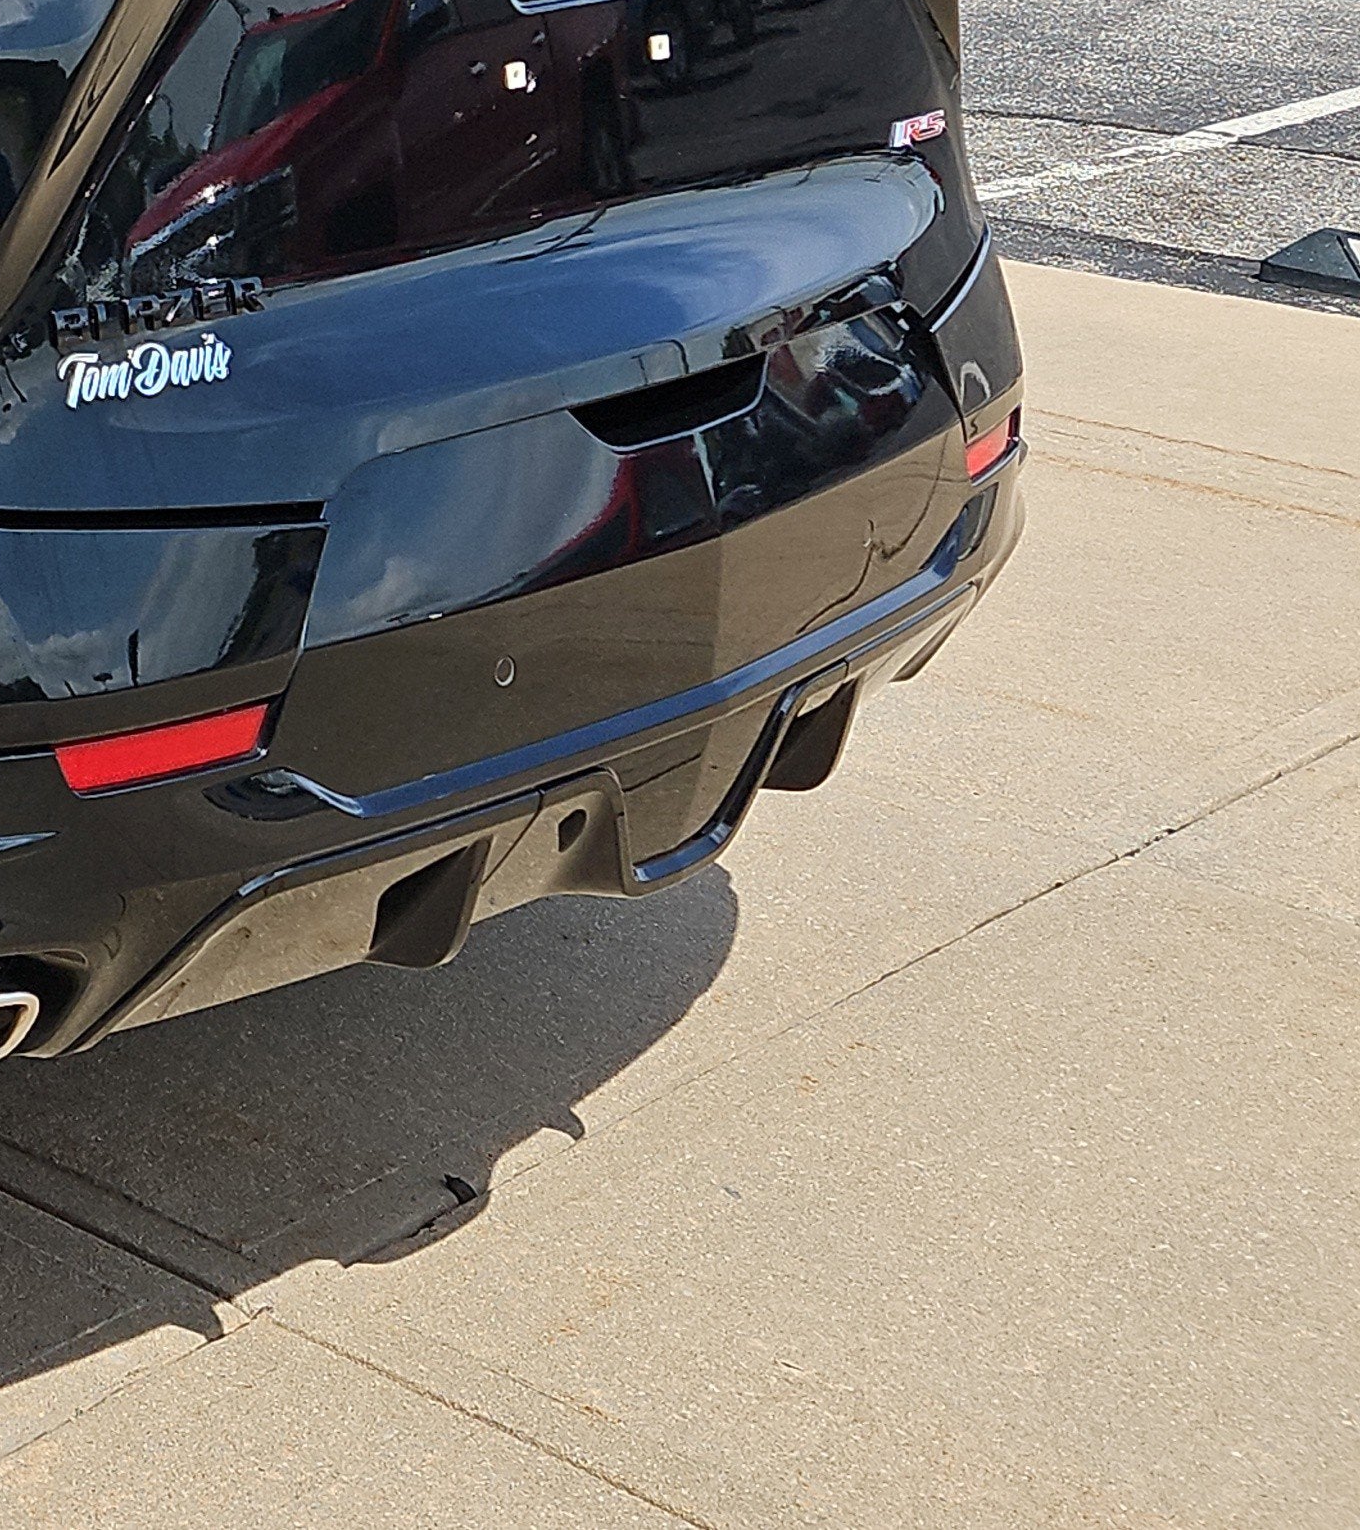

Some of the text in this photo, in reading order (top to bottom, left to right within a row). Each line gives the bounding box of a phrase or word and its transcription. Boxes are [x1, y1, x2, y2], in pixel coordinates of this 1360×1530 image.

[888, 108, 946, 148] RS
[56, 332, 233, 410] Tom Davis
